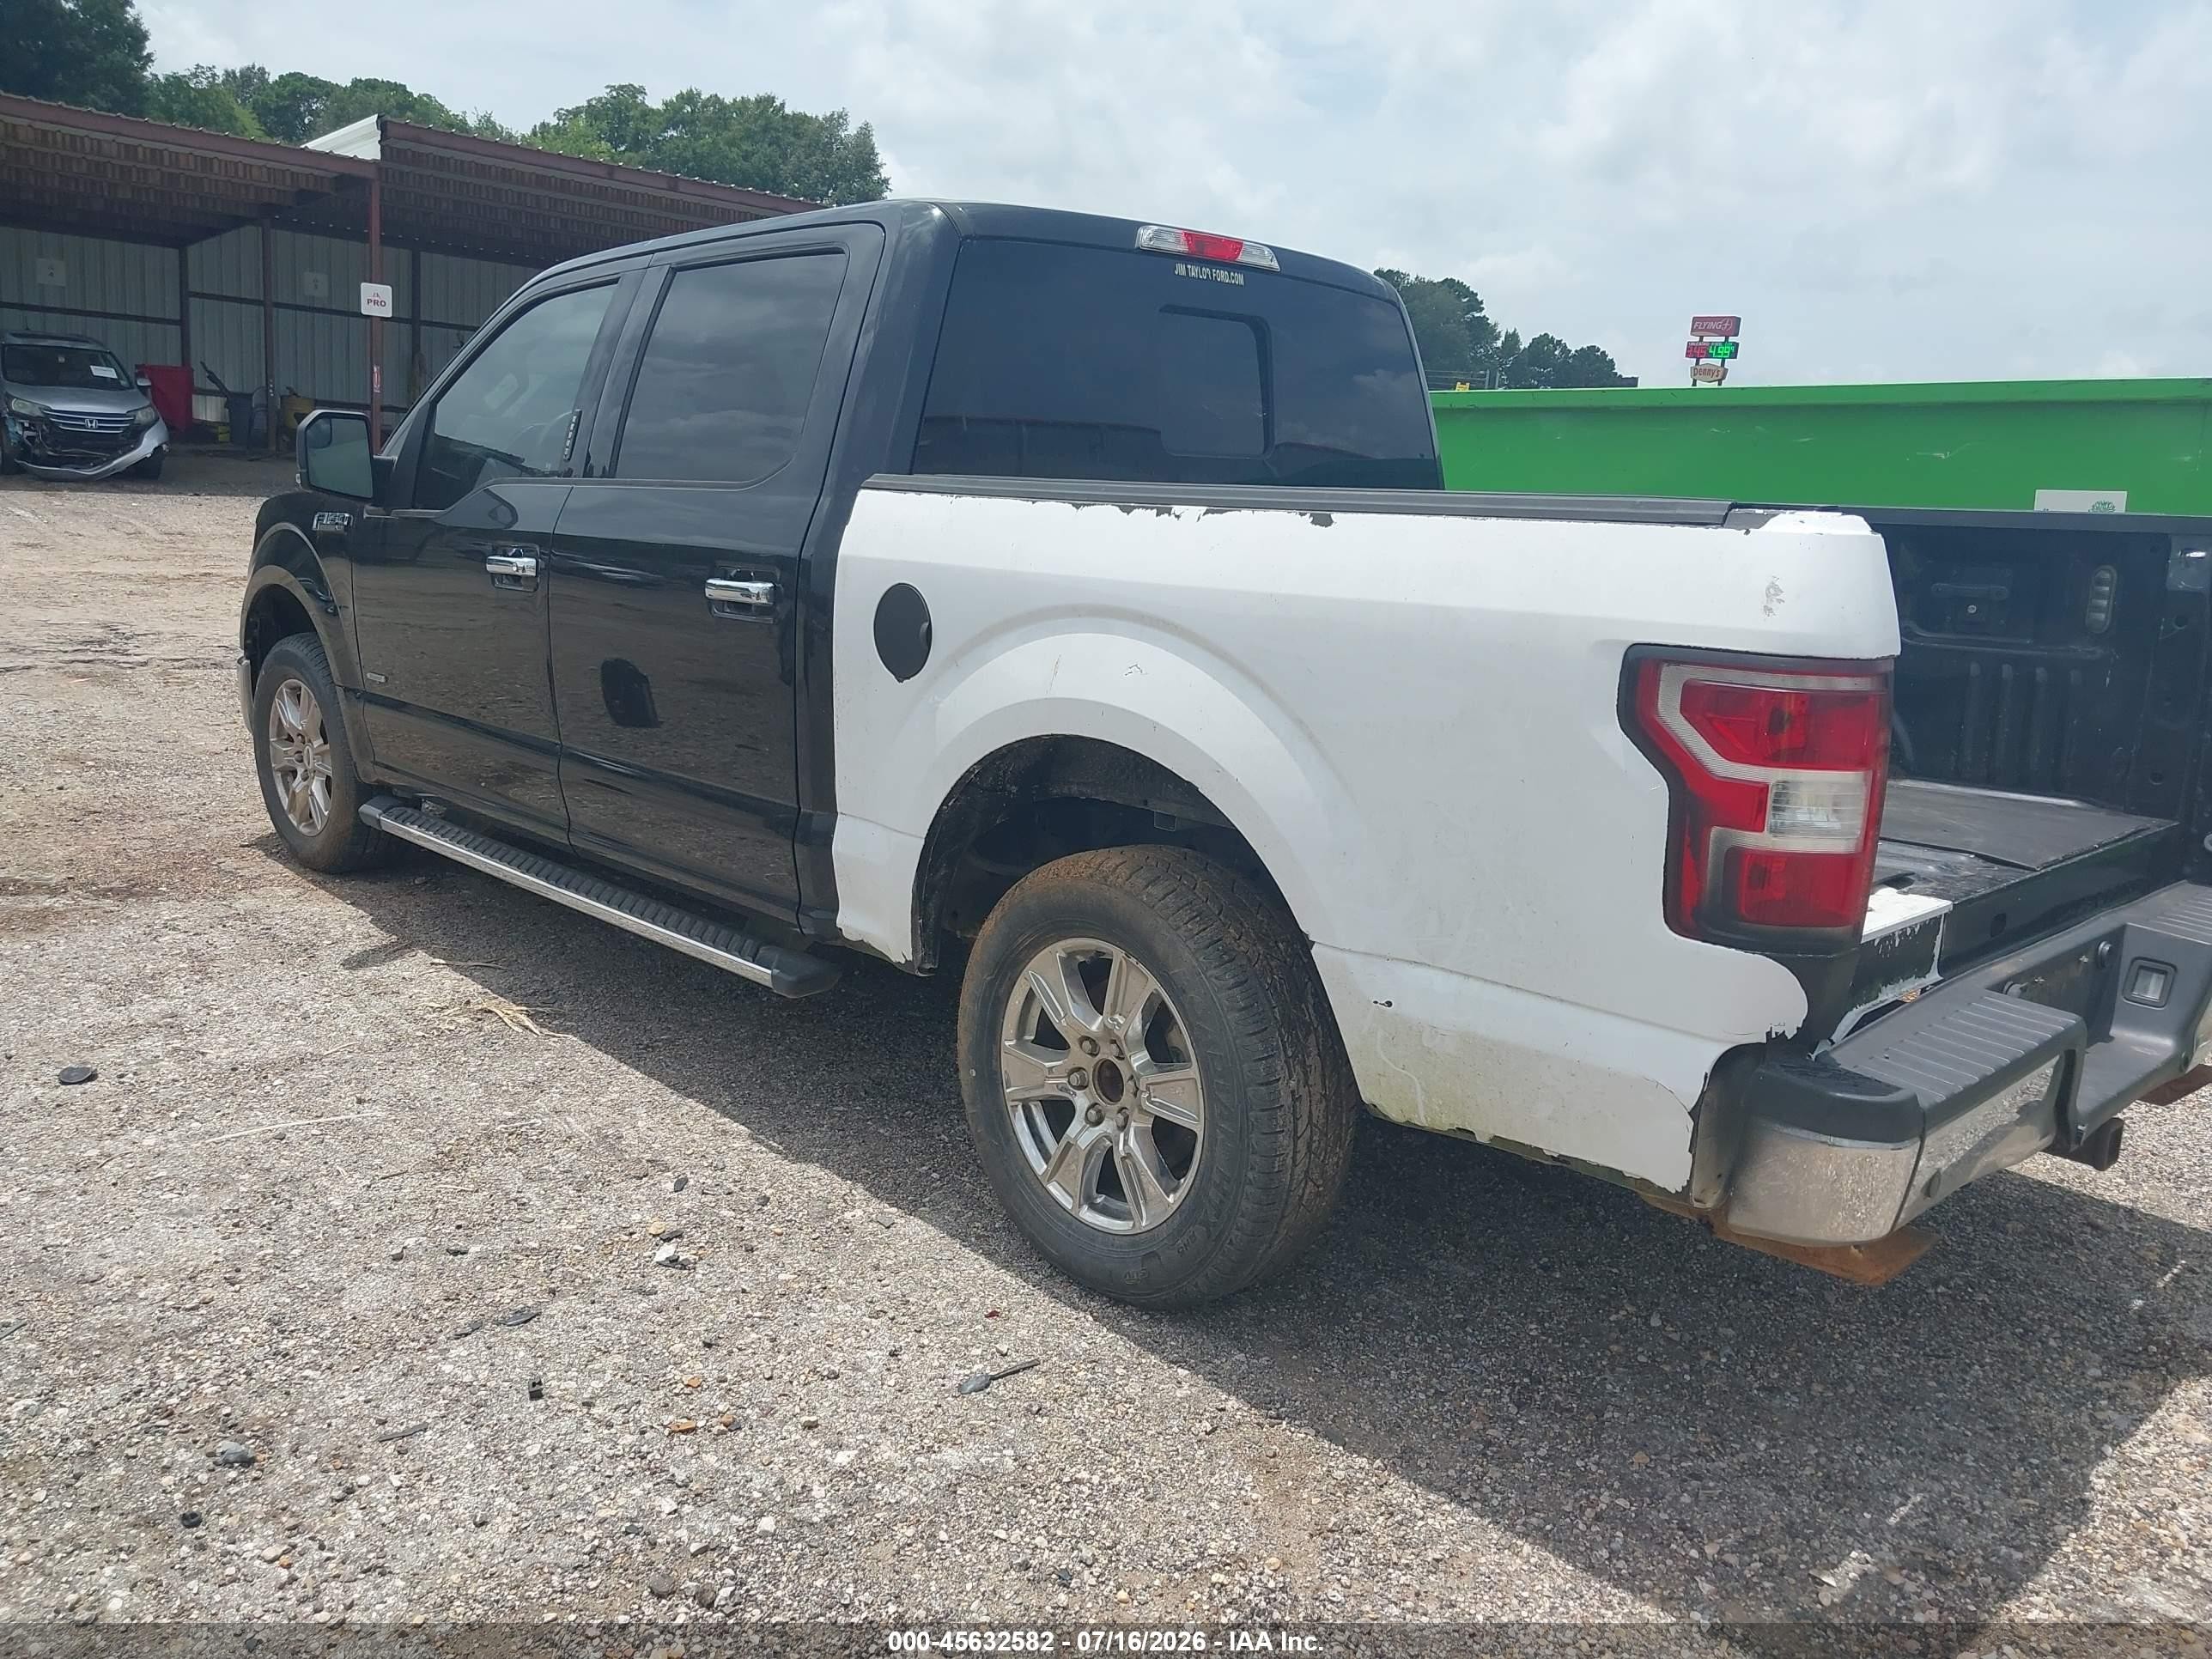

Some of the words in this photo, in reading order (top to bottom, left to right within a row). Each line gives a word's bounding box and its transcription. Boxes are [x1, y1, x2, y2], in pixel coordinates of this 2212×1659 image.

[1174, 263, 1187, 276] JIM
[1212, 268, 1244, 286] FORD.COM
[367, 298, 386, 307] PRO
[1693, 321, 1722, 330] FLYING
[1693, 367, 1721, 378] Denny's
